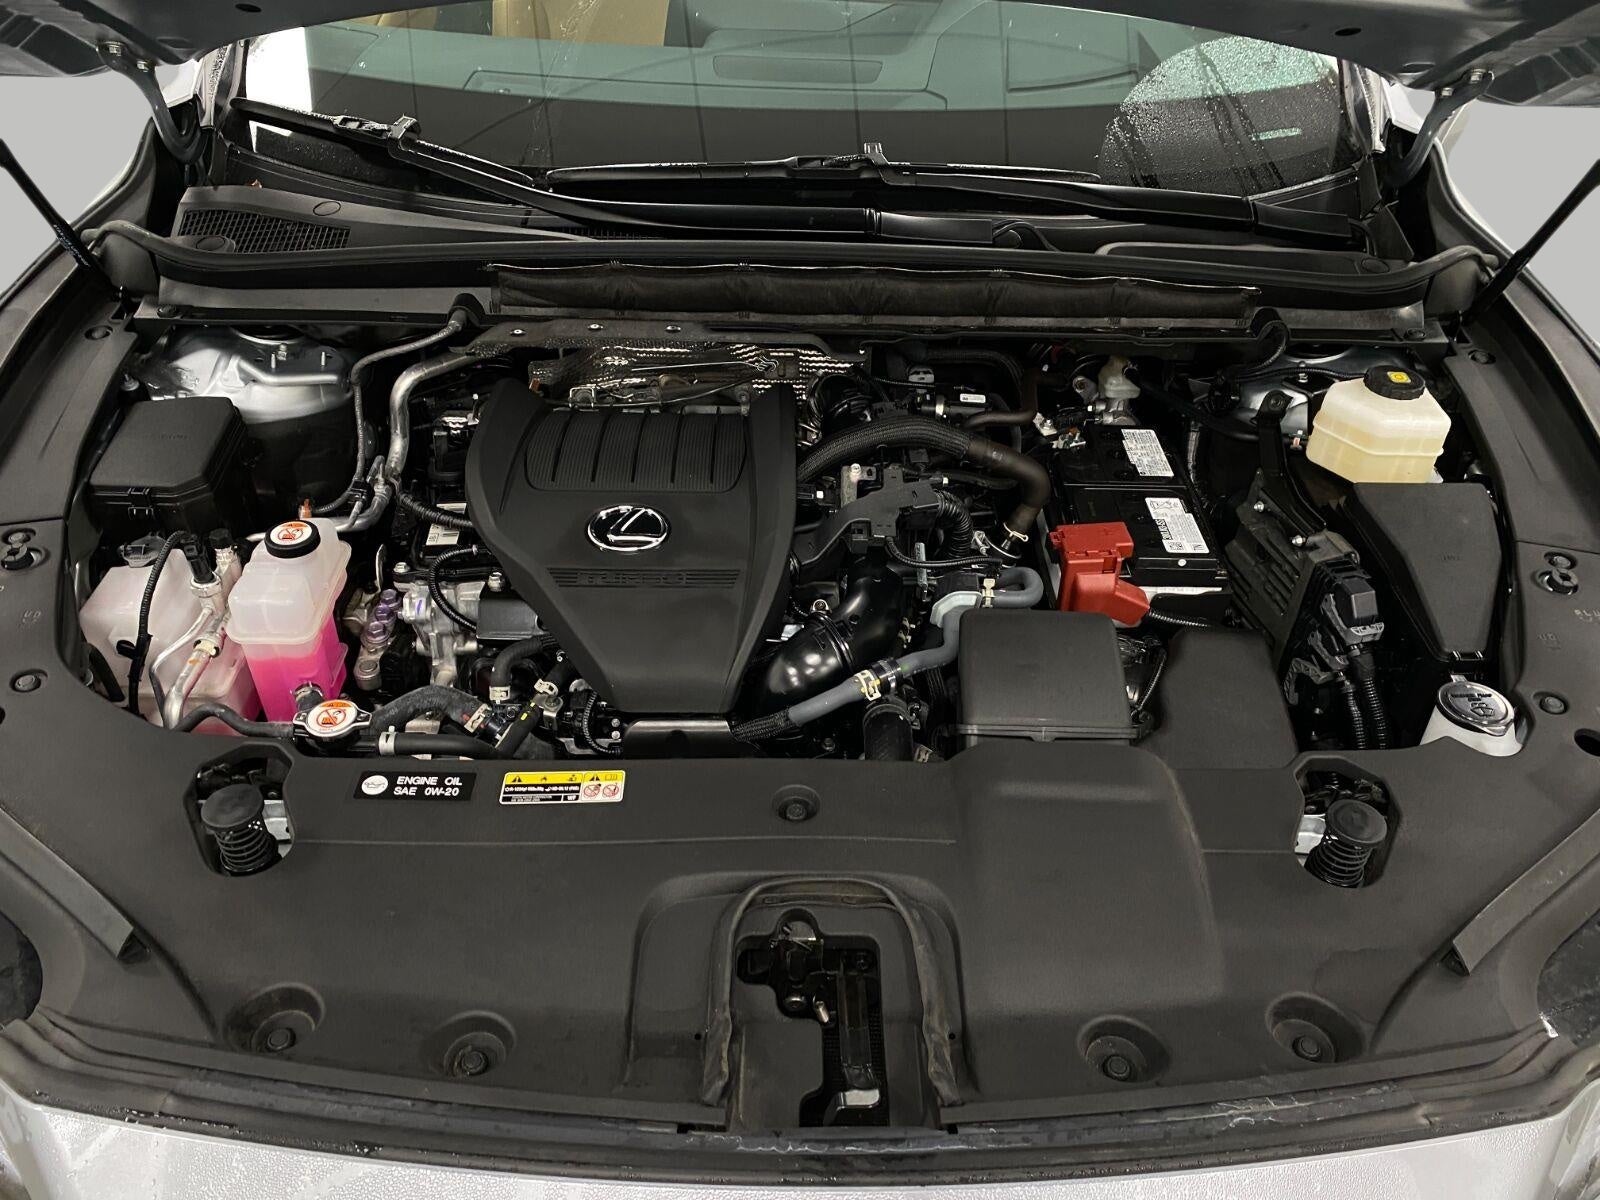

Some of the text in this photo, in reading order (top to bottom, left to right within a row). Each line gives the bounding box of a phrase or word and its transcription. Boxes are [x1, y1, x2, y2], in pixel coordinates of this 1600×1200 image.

[396, 776, 463, 786] ENGINE OIL
[393, 786, 460, 797] SAE 0W-20
